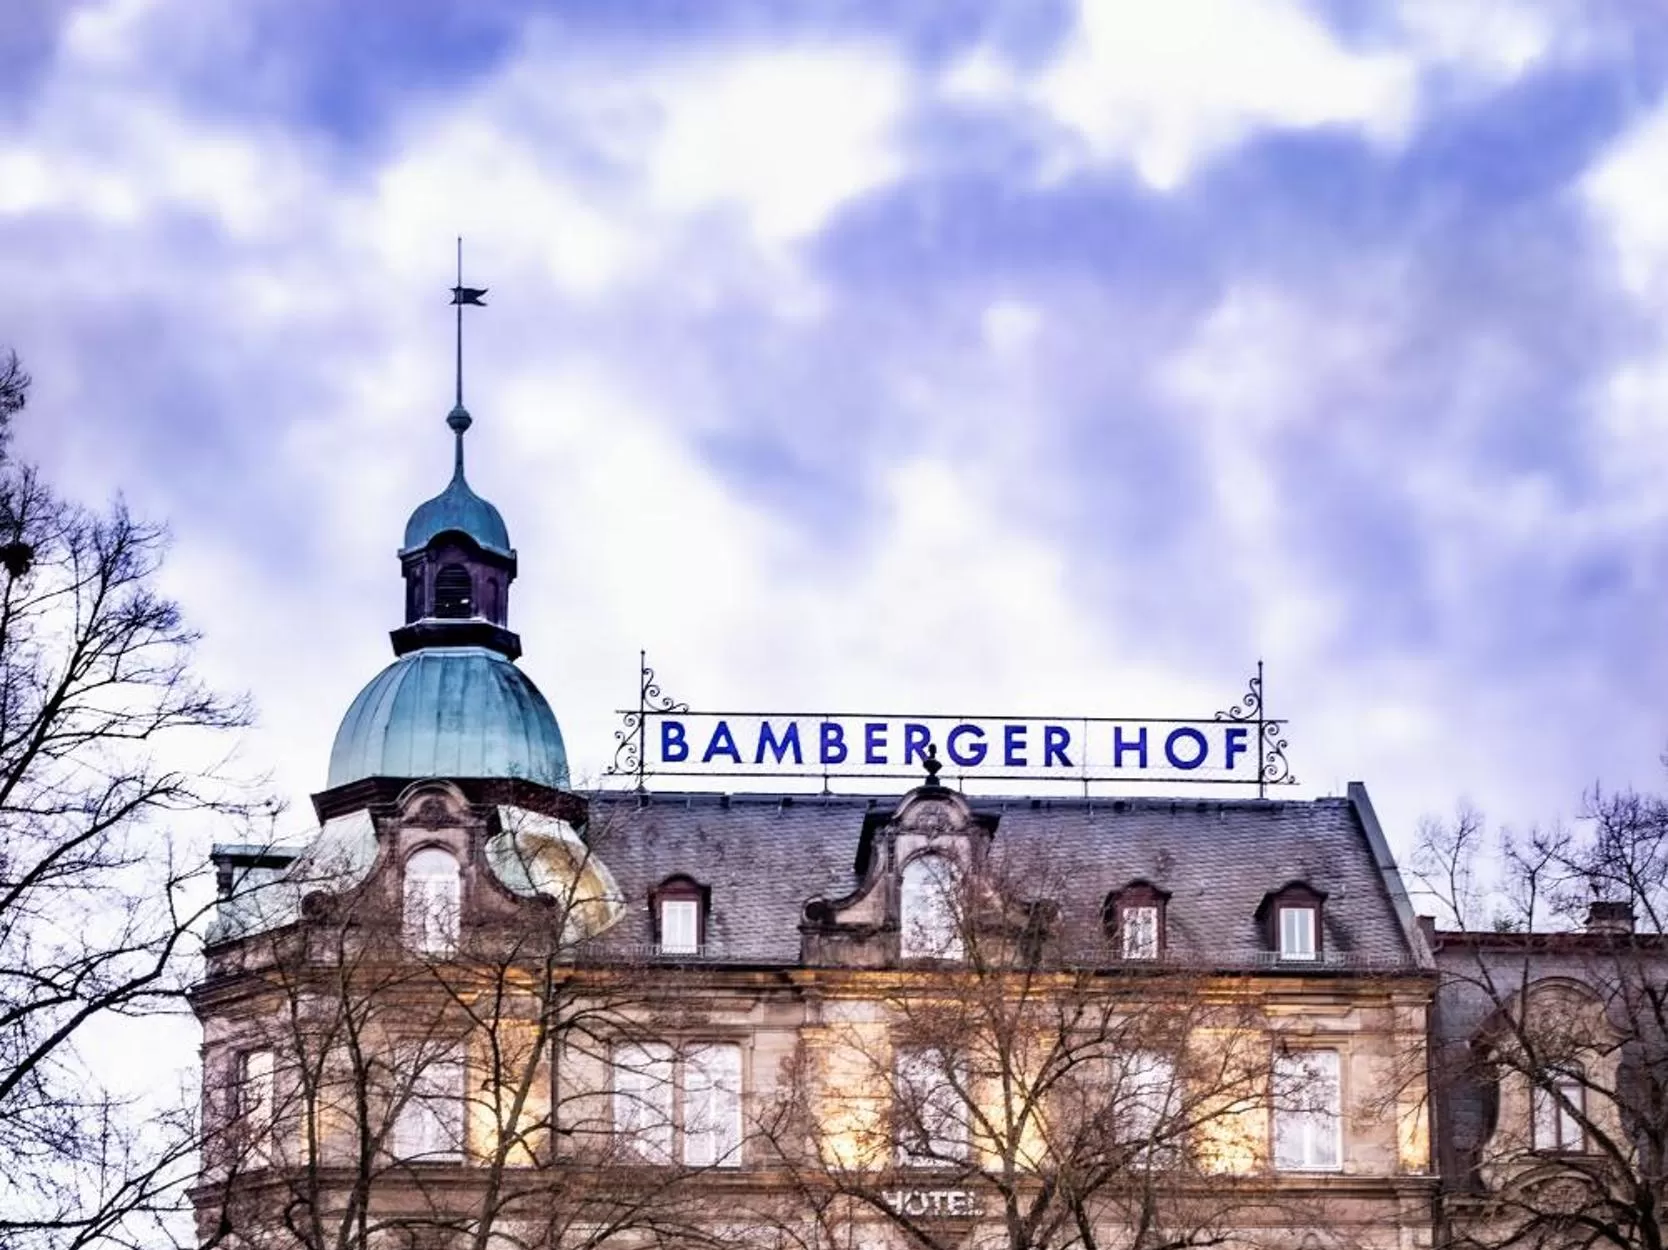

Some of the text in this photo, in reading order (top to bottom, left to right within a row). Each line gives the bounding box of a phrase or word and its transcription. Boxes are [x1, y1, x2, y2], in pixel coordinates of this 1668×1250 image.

[660, 720, 1249, 770] BAMBERGER HOF
[881, 1191, 984, 1216] HOTEL
